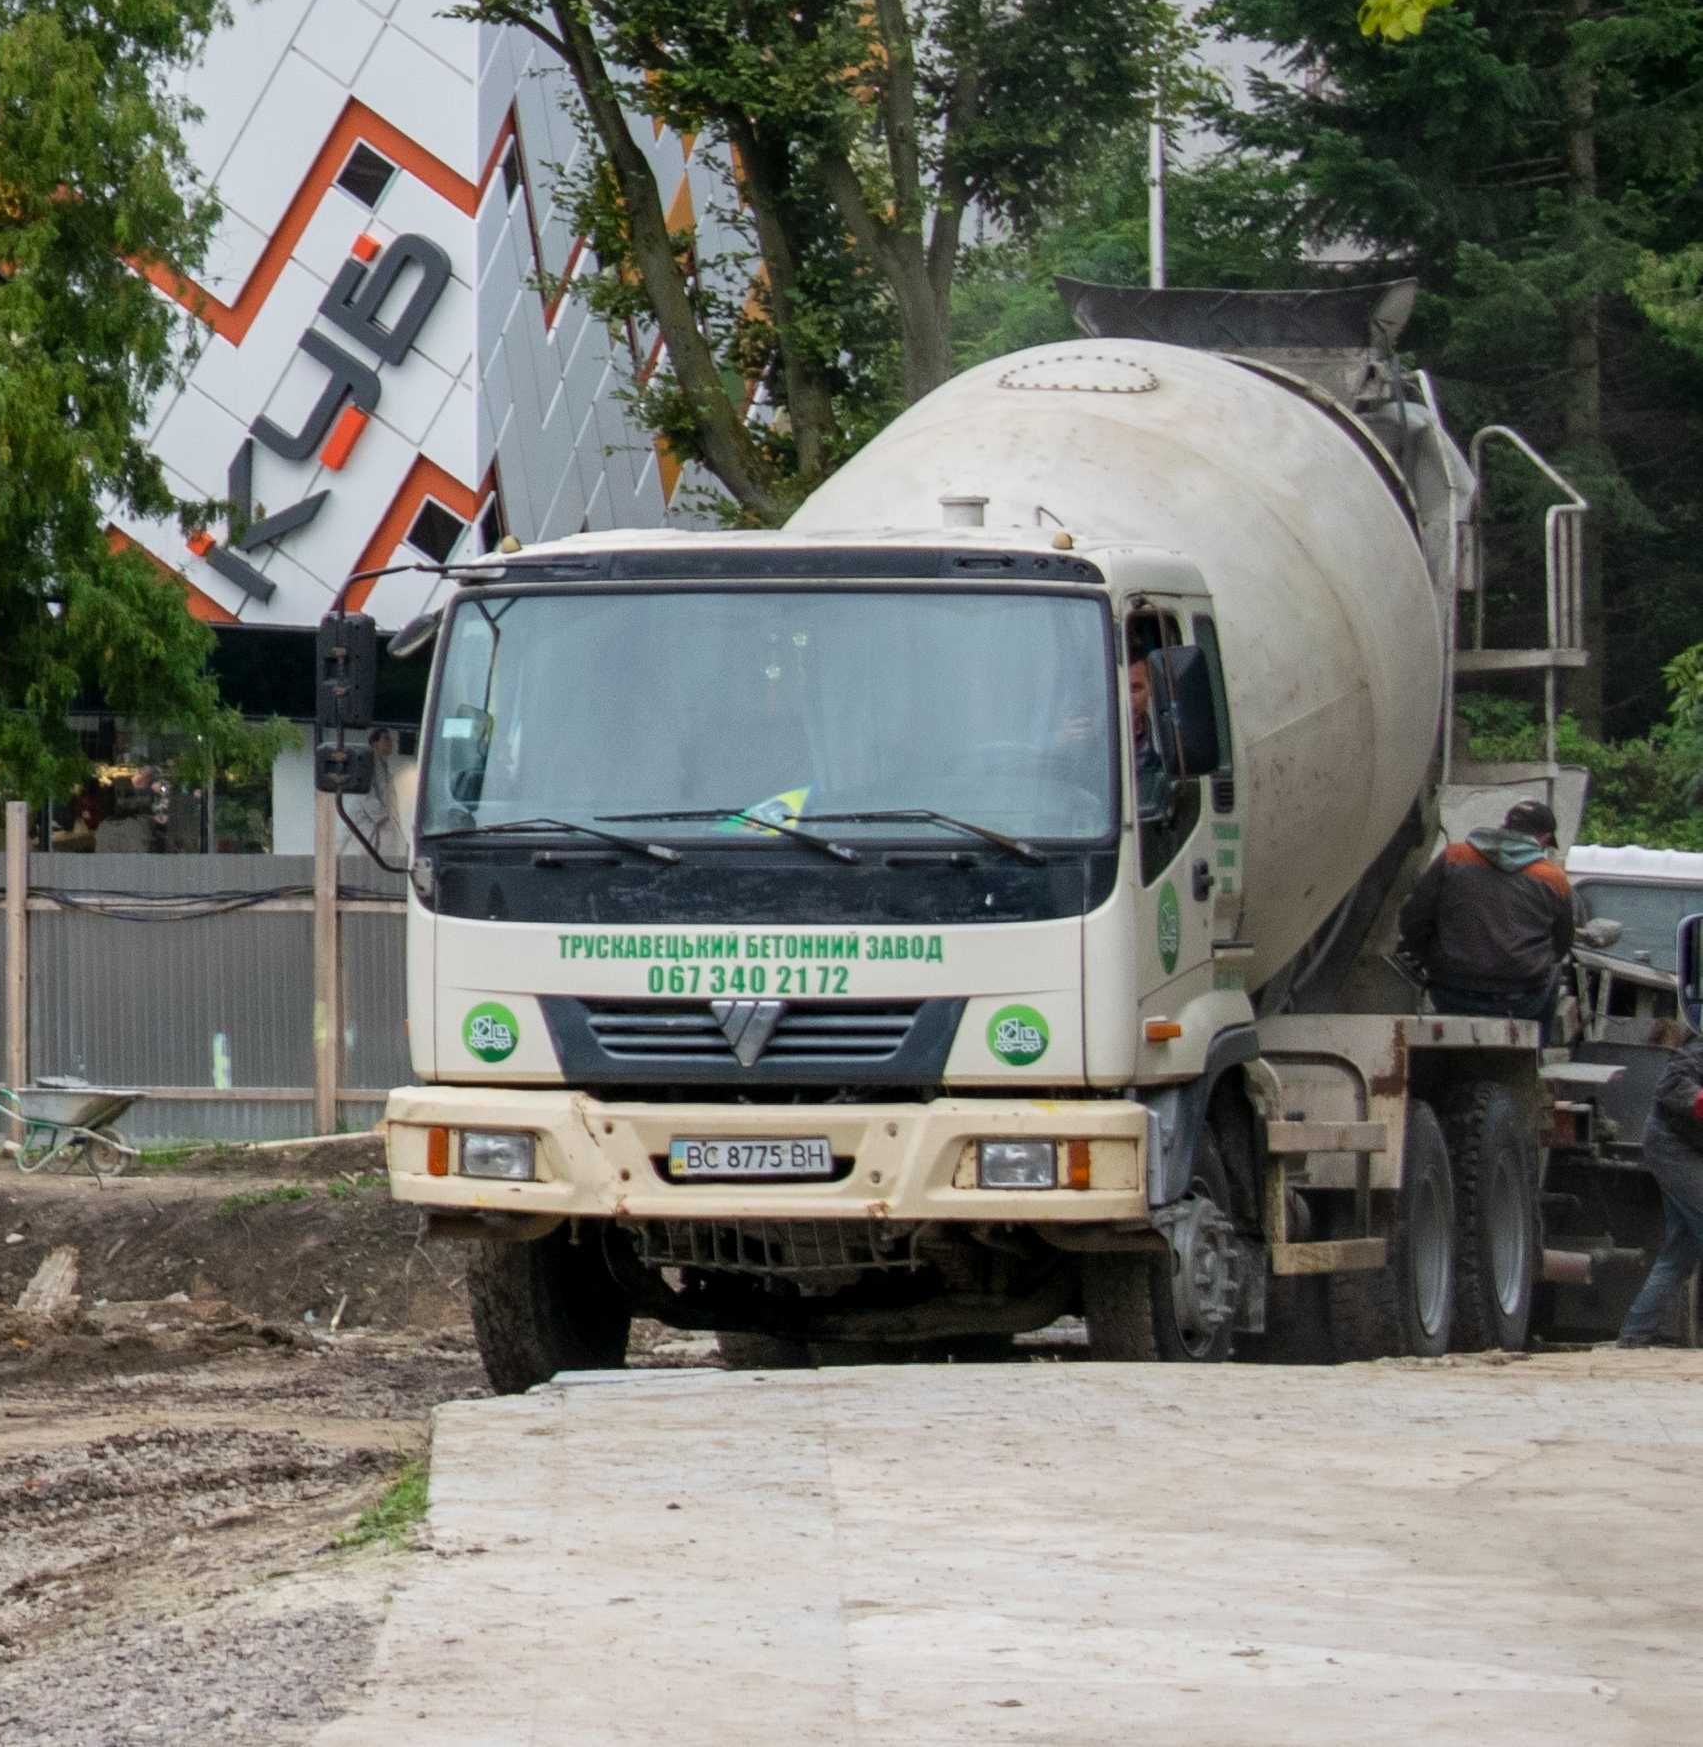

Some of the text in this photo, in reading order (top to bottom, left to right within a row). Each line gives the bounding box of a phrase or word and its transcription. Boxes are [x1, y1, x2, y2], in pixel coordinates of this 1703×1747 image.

[187, 233, 452, 604] КУБ
[558, 931, 943, 963] ТРУСКАВЕЦЬКИЙ БЕТОННИЙ ЗАВОД
[647, 966, 701, 994] 067
[709, 966, 766, 994] 340
[687, 1146, 719, 1169] BC
[727, 1145, 783, 1169] 8775
